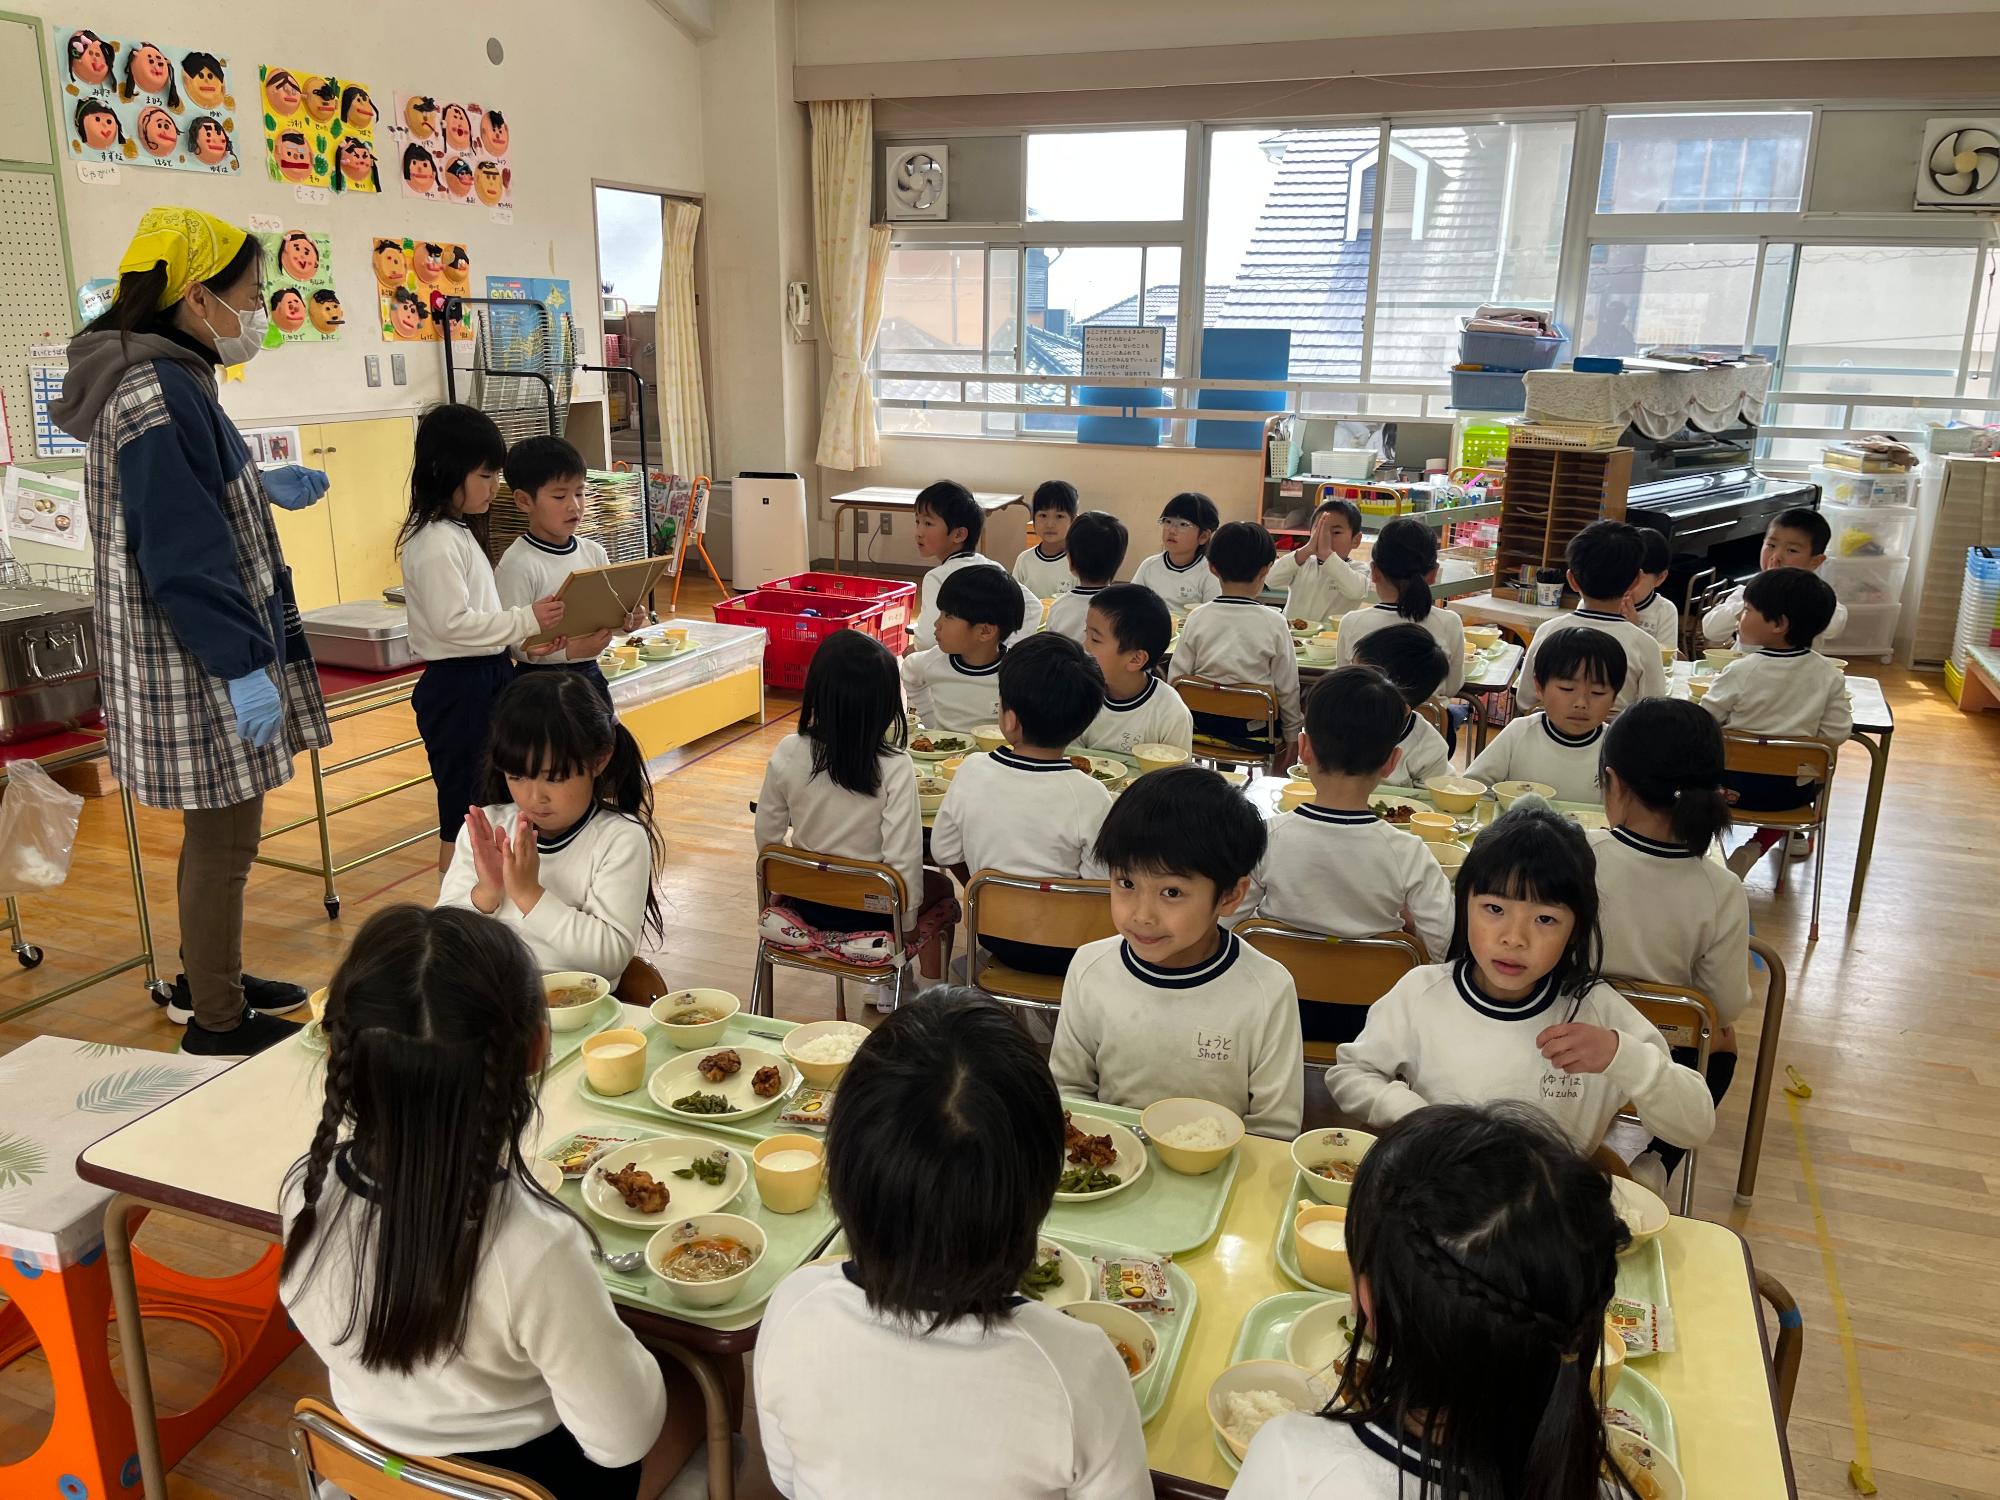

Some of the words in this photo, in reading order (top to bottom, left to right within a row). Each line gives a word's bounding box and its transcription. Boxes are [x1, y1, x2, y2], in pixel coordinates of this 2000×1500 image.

[1197, 1031, 1232, 1050] しょうと
[1197, 1047, 1230, 1061] Shoto
[1543, 1069, 1582, 1087] ゆずは
[1542, 1086, 1578, 1098] Yuzuha
